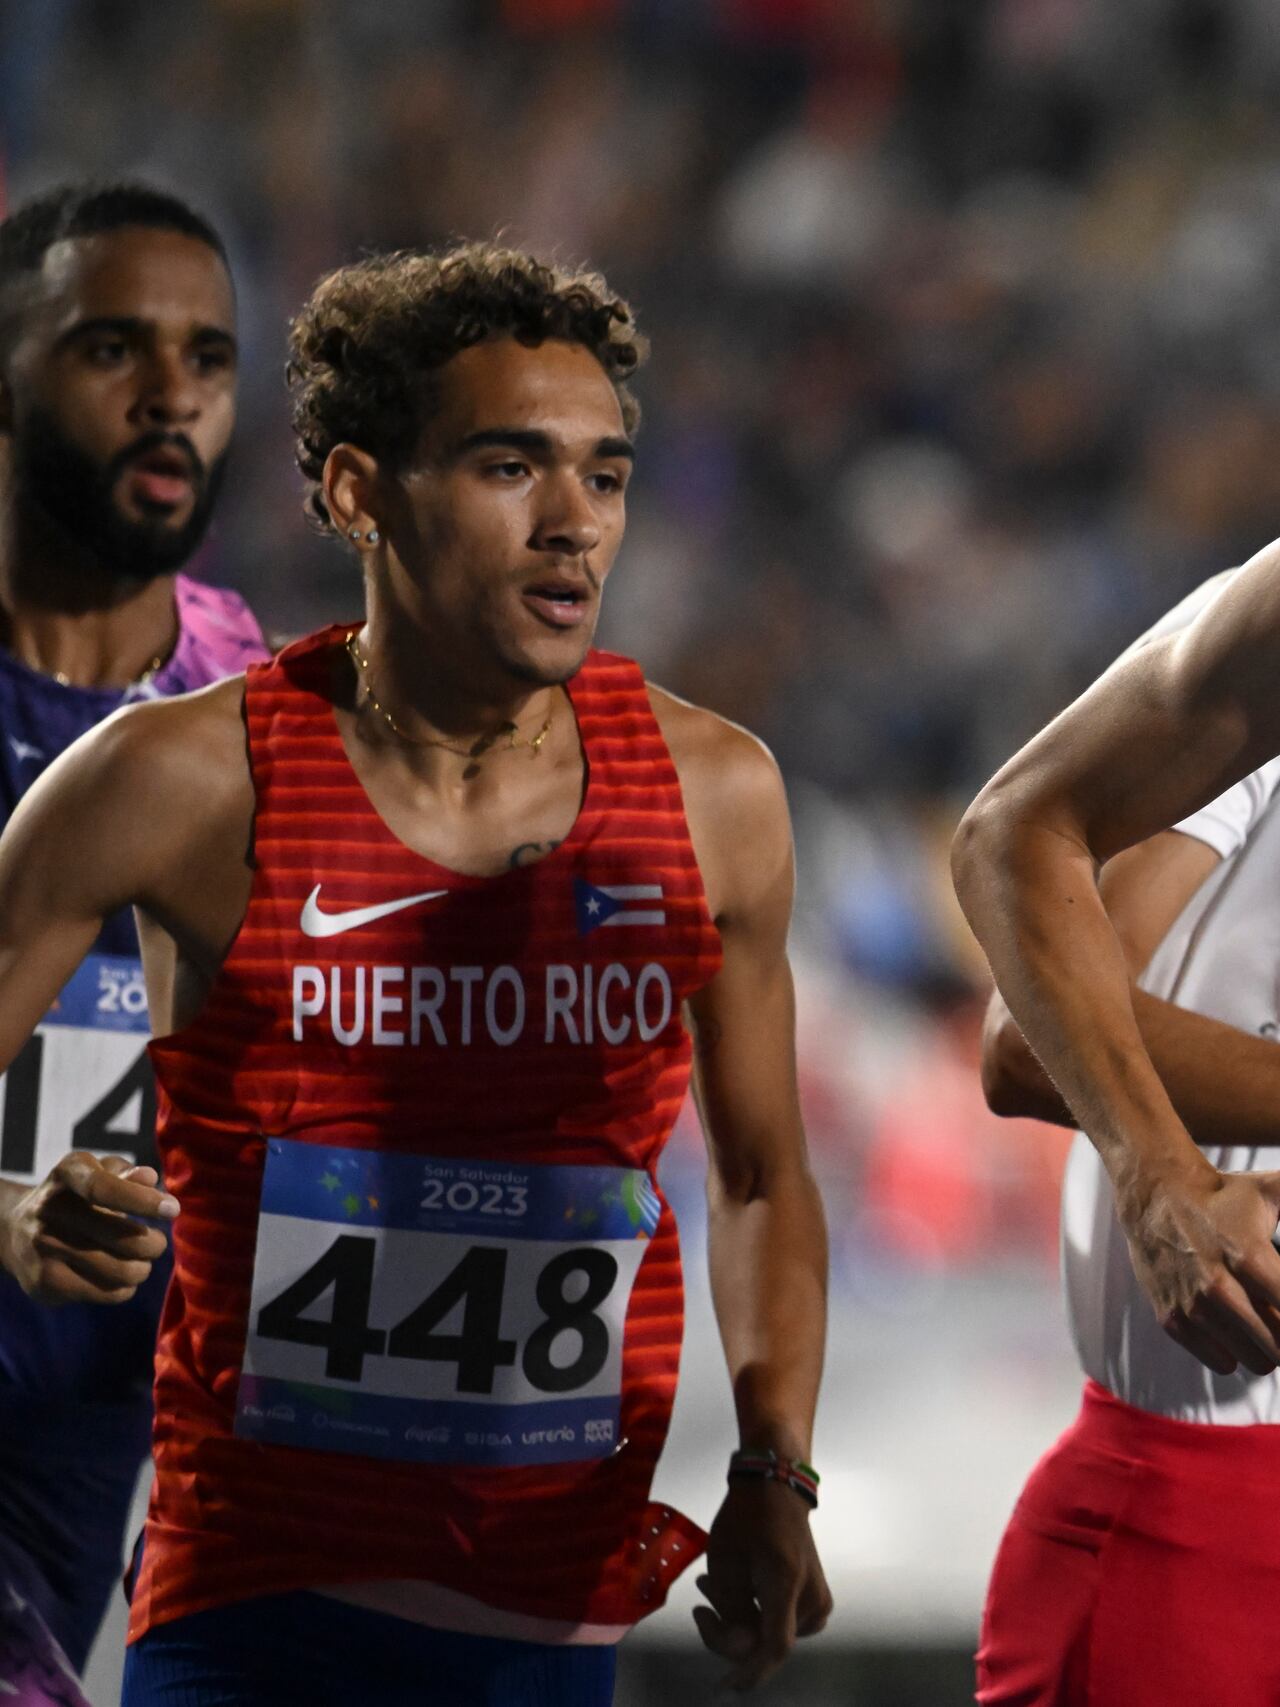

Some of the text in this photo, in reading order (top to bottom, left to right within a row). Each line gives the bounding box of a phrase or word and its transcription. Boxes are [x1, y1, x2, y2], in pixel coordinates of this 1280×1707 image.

[97, 981, 148, 1015] 20
[292, 961, 673, 1048] PUERTO RICO
[0, 1034, 158, 1177] 14
[420, 1179, 528, 1217] 2023
[424, 1164, 529, 1184] San Salvador
[257, 1235, 618, 1394] 448
